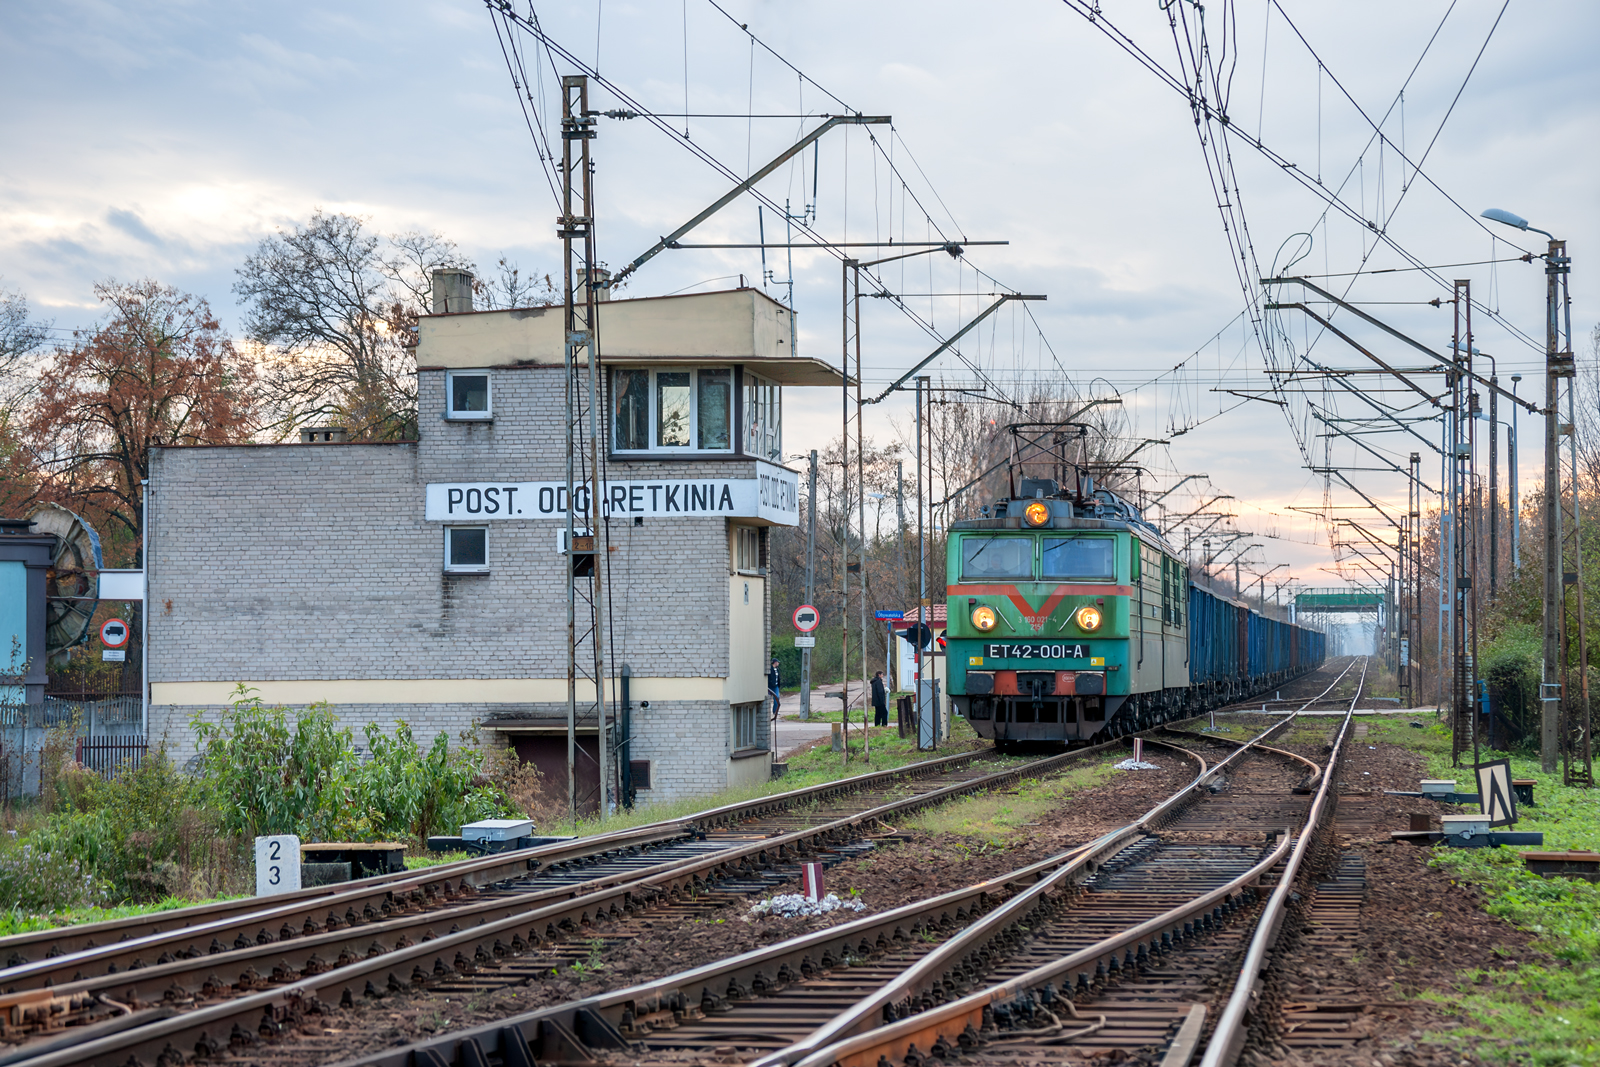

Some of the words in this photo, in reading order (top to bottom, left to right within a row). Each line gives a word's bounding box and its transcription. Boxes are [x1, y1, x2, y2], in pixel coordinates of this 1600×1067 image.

[448, 487, 523, 514] POST.
[610, 484, 735, 513] RETKINIA
[989, 644, 1083, 658] ET42-001-A
[269, 840, 281, 861] 2
[269, 865, 281, 885] 3
